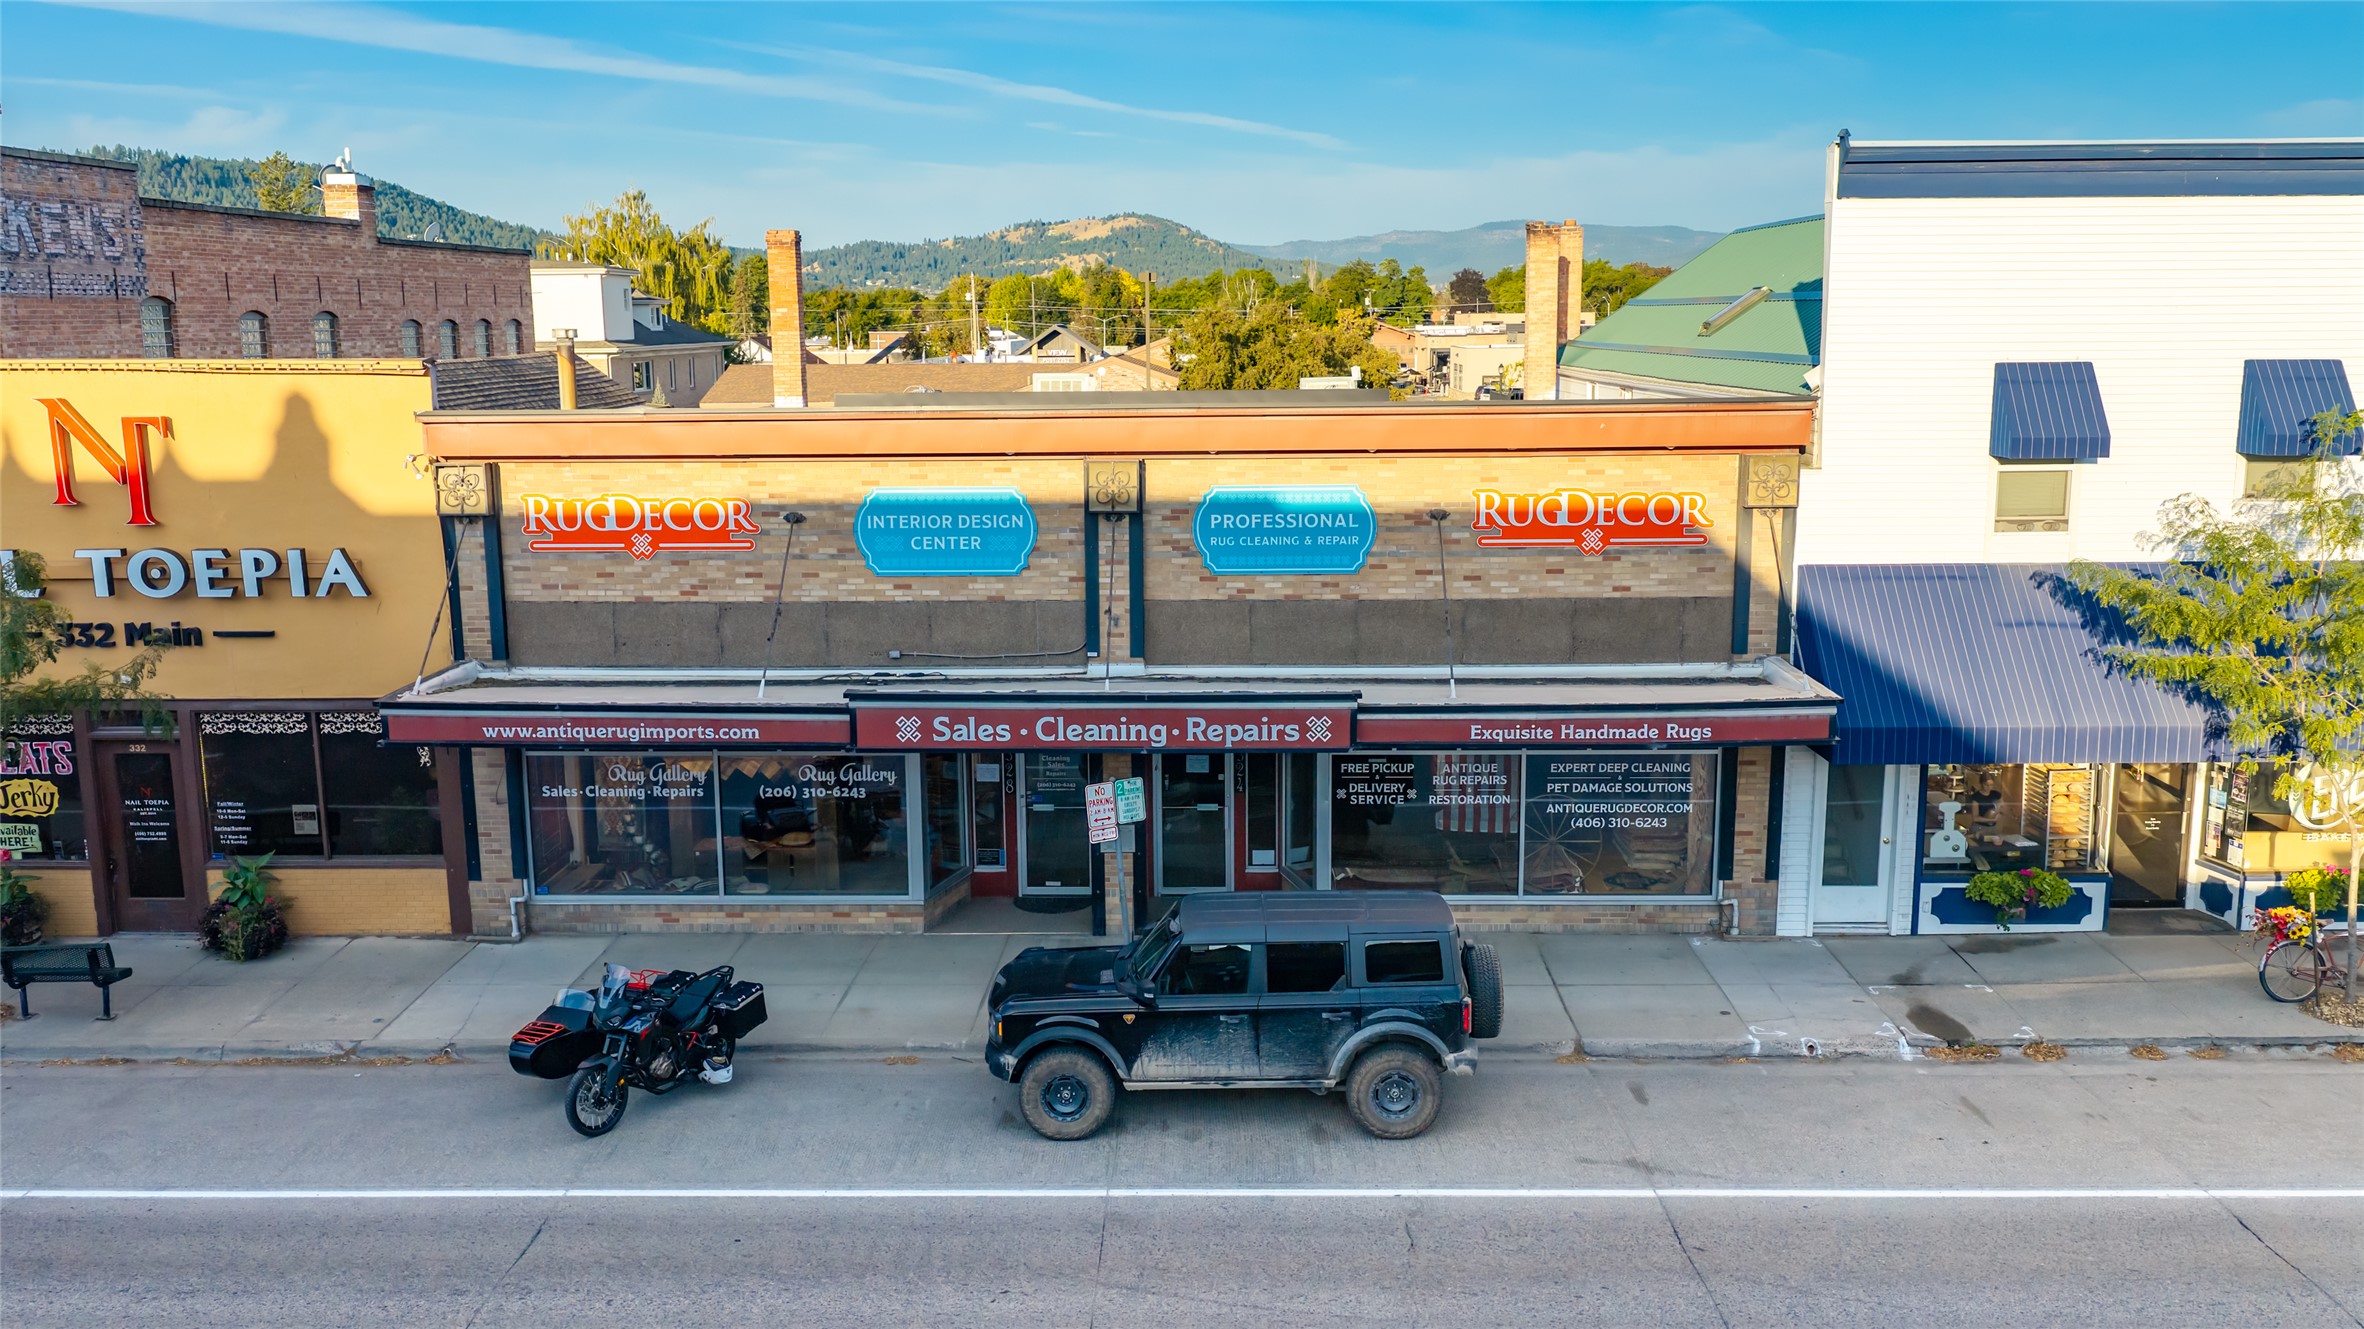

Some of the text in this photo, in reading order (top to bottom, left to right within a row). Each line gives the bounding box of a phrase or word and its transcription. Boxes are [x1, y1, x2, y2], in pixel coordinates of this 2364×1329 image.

[867, 514, 1024, 530] INTERIOR DESIGN
[1210, 514, 1359, 529] PROFESSIONAL
[911, 536, 982, 551] CENTER
[1210, 536, 1359, 546] RUG CLEANING & REPAIR
[73, 547, 371, 598] TOEPIA
[55, 621, 203, 648] 332 Main
[483, 723, 760, 743] www.antiquerugimports.com
[932, 716, 1300, 747] Sales Cleaning Repairs
[1470, 723, 1712, 742] Exquisite Handmade Rugs
[129, 744, 146, 752] 332
[1041, 755, 1071, 763] Cleaning
[1341, 763, 1415, 773] FREE PICKUP
[1442, 763, 1498, 773] ANTIQUE
[1550, 762, 1691, 773] EXPERT DEEP CLEANING
[608, 762, 707, 786] Rug Gallery
[798, 762, 897, 786] Rug Gallery
[1432, 775, 1508, 785] RUG REPAIRS
[542, 785, 704, 800] Sales Cleaning Repairs
[759, 784, 867, 799] (206) 310-6243
[1094, 787, 1106, 797] NO
[1116, 783, 1123, 794] 2
[1349, 783, 1406, 793] DELIVERY
[1547, 783, 1693, 793] PET DAMAGE SOLUTIONS
[0, 781, 55, 814] Jerky
[1089, 797, 1114, 807] PARKING
[1349, 795, 1405, 805] SERVICE
[1429, 795, 1511, 805] RESTORATION
[1546, 803, 1694, 813] ANTIQUERUGDECOR.COM
[1570, 817, 1667, 829] (406) 310-6243
[0, 836, 34, 847] HERE!
